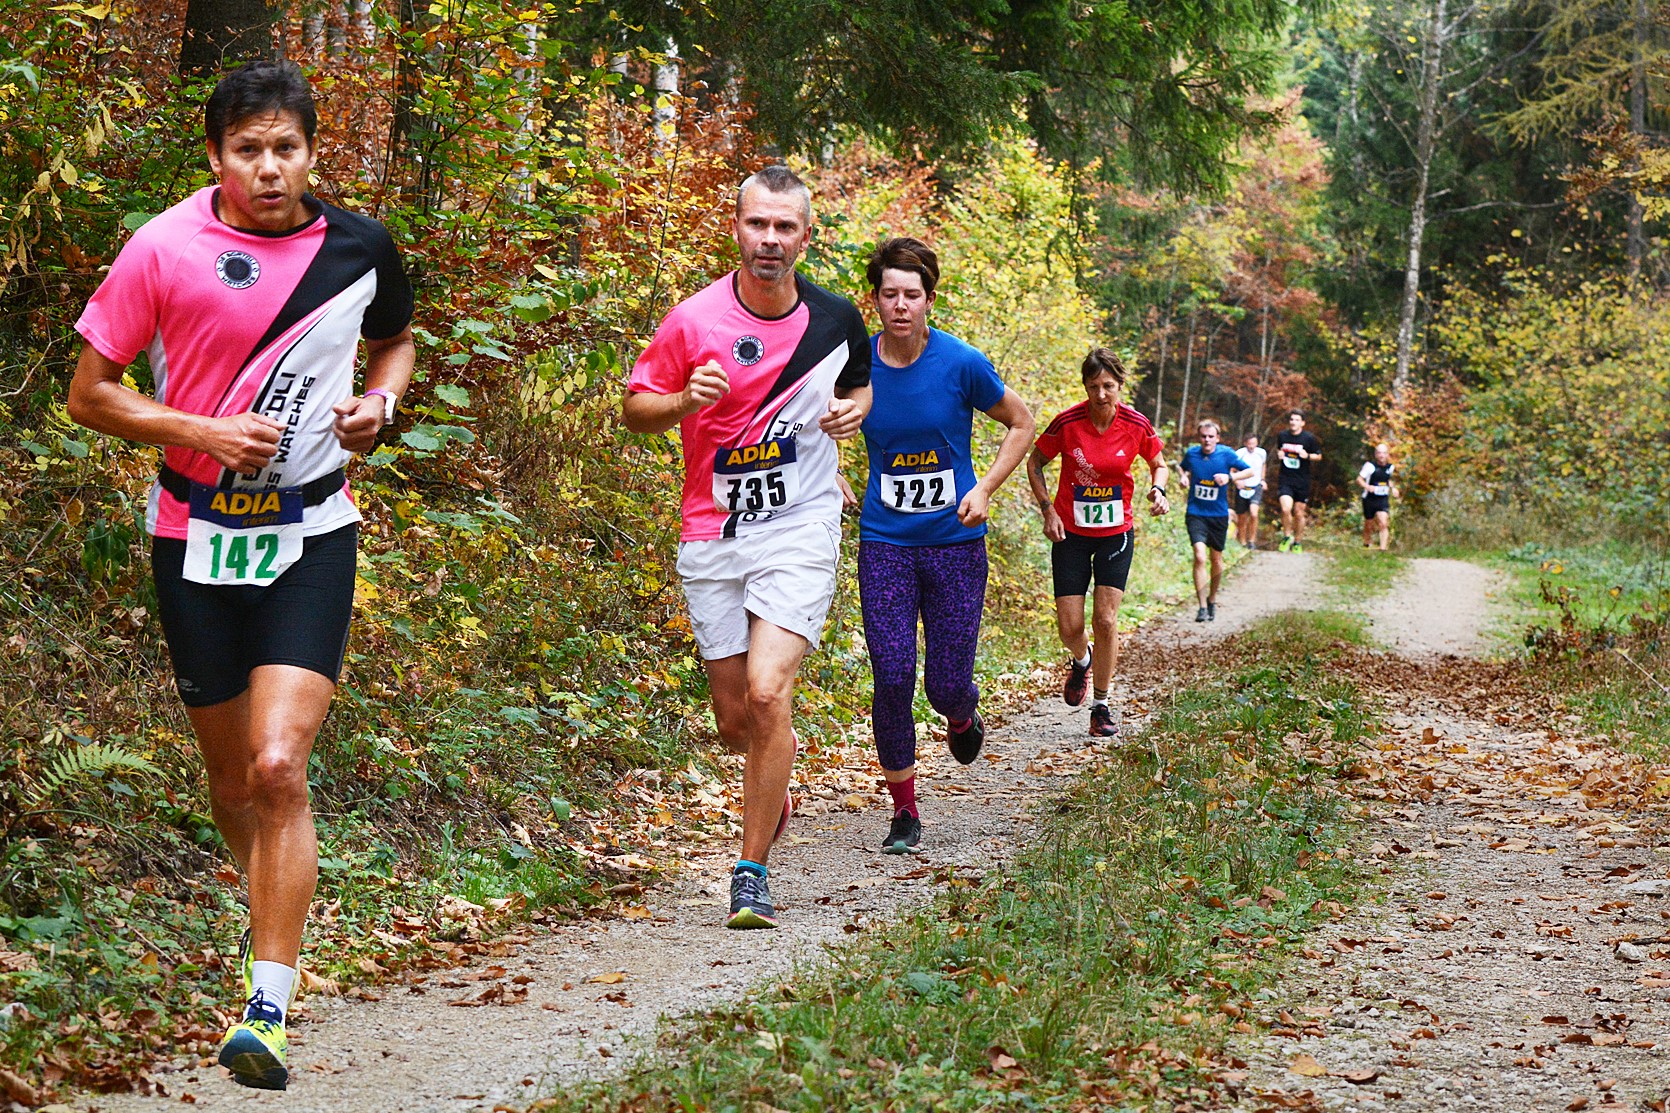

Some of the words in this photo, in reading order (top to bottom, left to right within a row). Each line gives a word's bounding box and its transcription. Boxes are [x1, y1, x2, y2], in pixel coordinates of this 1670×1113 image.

[275, 375, 316, 463] WATCHES
[726, 441, 782, 466] ADIA
[891, 450, 939, 468] ADIA
[210, 492, 281, 515] ADIA
[727, 471, 787, 511] 735
[893, 477, 946, 508] 722
[1082, 487, 1114, 497] ADIA
[1083, 503, 1114, 524] 121
[210, 533, 279, 579] 142
